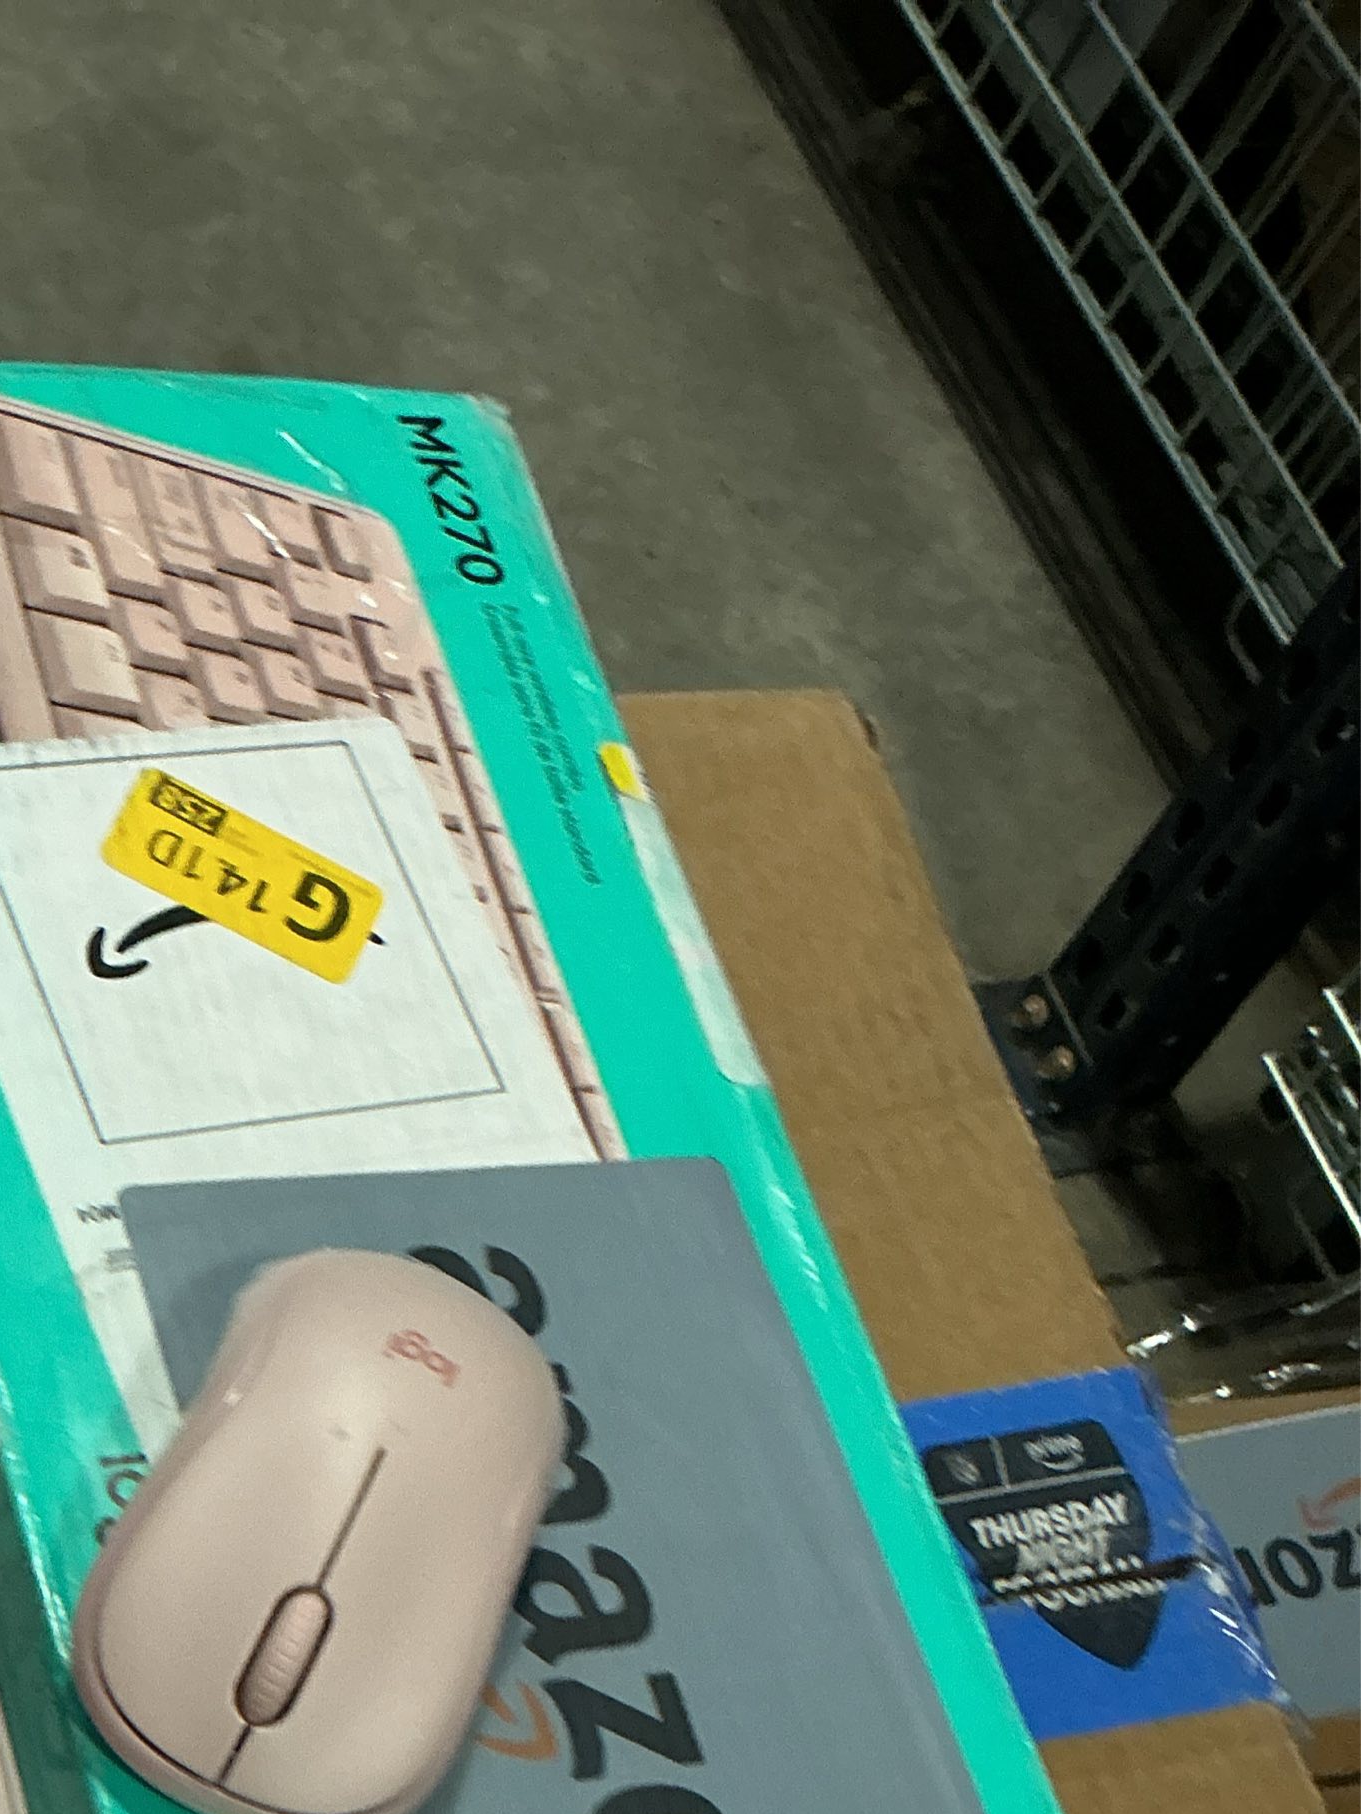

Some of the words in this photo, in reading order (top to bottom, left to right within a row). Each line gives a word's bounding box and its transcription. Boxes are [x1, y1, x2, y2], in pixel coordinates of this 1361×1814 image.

[397, 415, 506, 586] MK270
[284, 870, 350, 942] G
[968, 1490, 1131, 1550] THURSDAY
